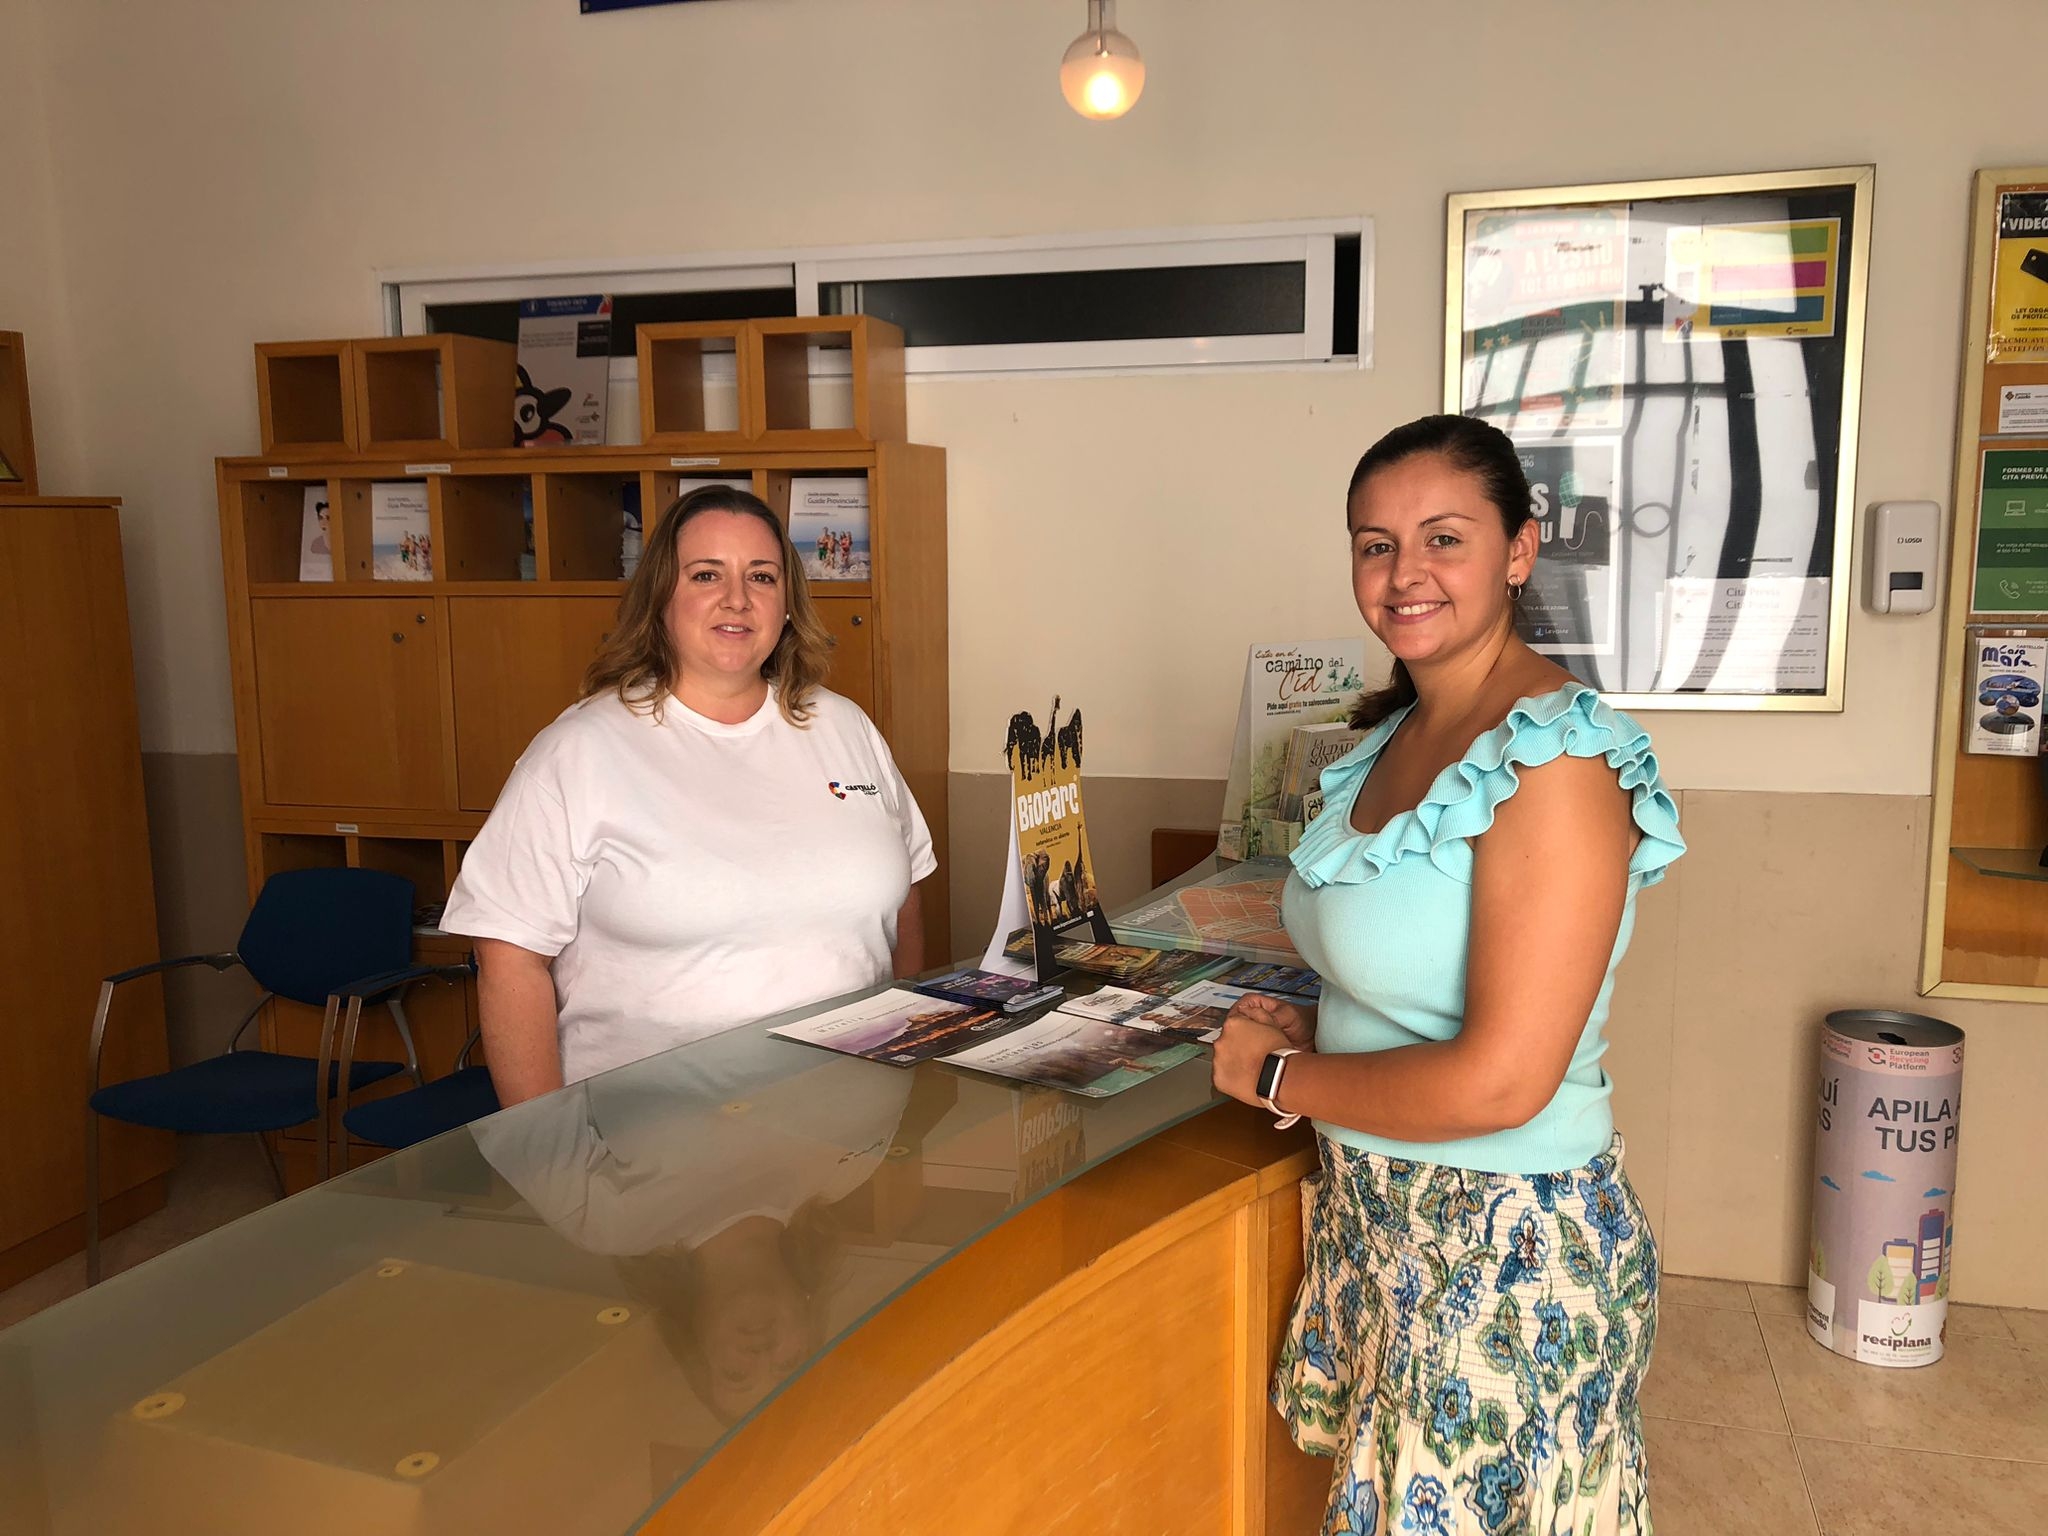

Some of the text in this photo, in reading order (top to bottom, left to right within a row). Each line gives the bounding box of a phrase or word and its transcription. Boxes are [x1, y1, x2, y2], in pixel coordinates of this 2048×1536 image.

[1265, 654, 1345, 673] camino del
[1279, 661, 1322, 701] Cid
[1311, 743, 1354, 758] CIUDAD
[1889, 1049, 1930, 1057] European
[1889, 1056, 1930, 1064] Recycling
[1889, 1063, 1926, 1071] Platform
[1867, 1097, 1951, 1123] APILA
[1875, 1126, 1936, 1153] TUS
[1863, 1334, 1932, 1352] reciplana
